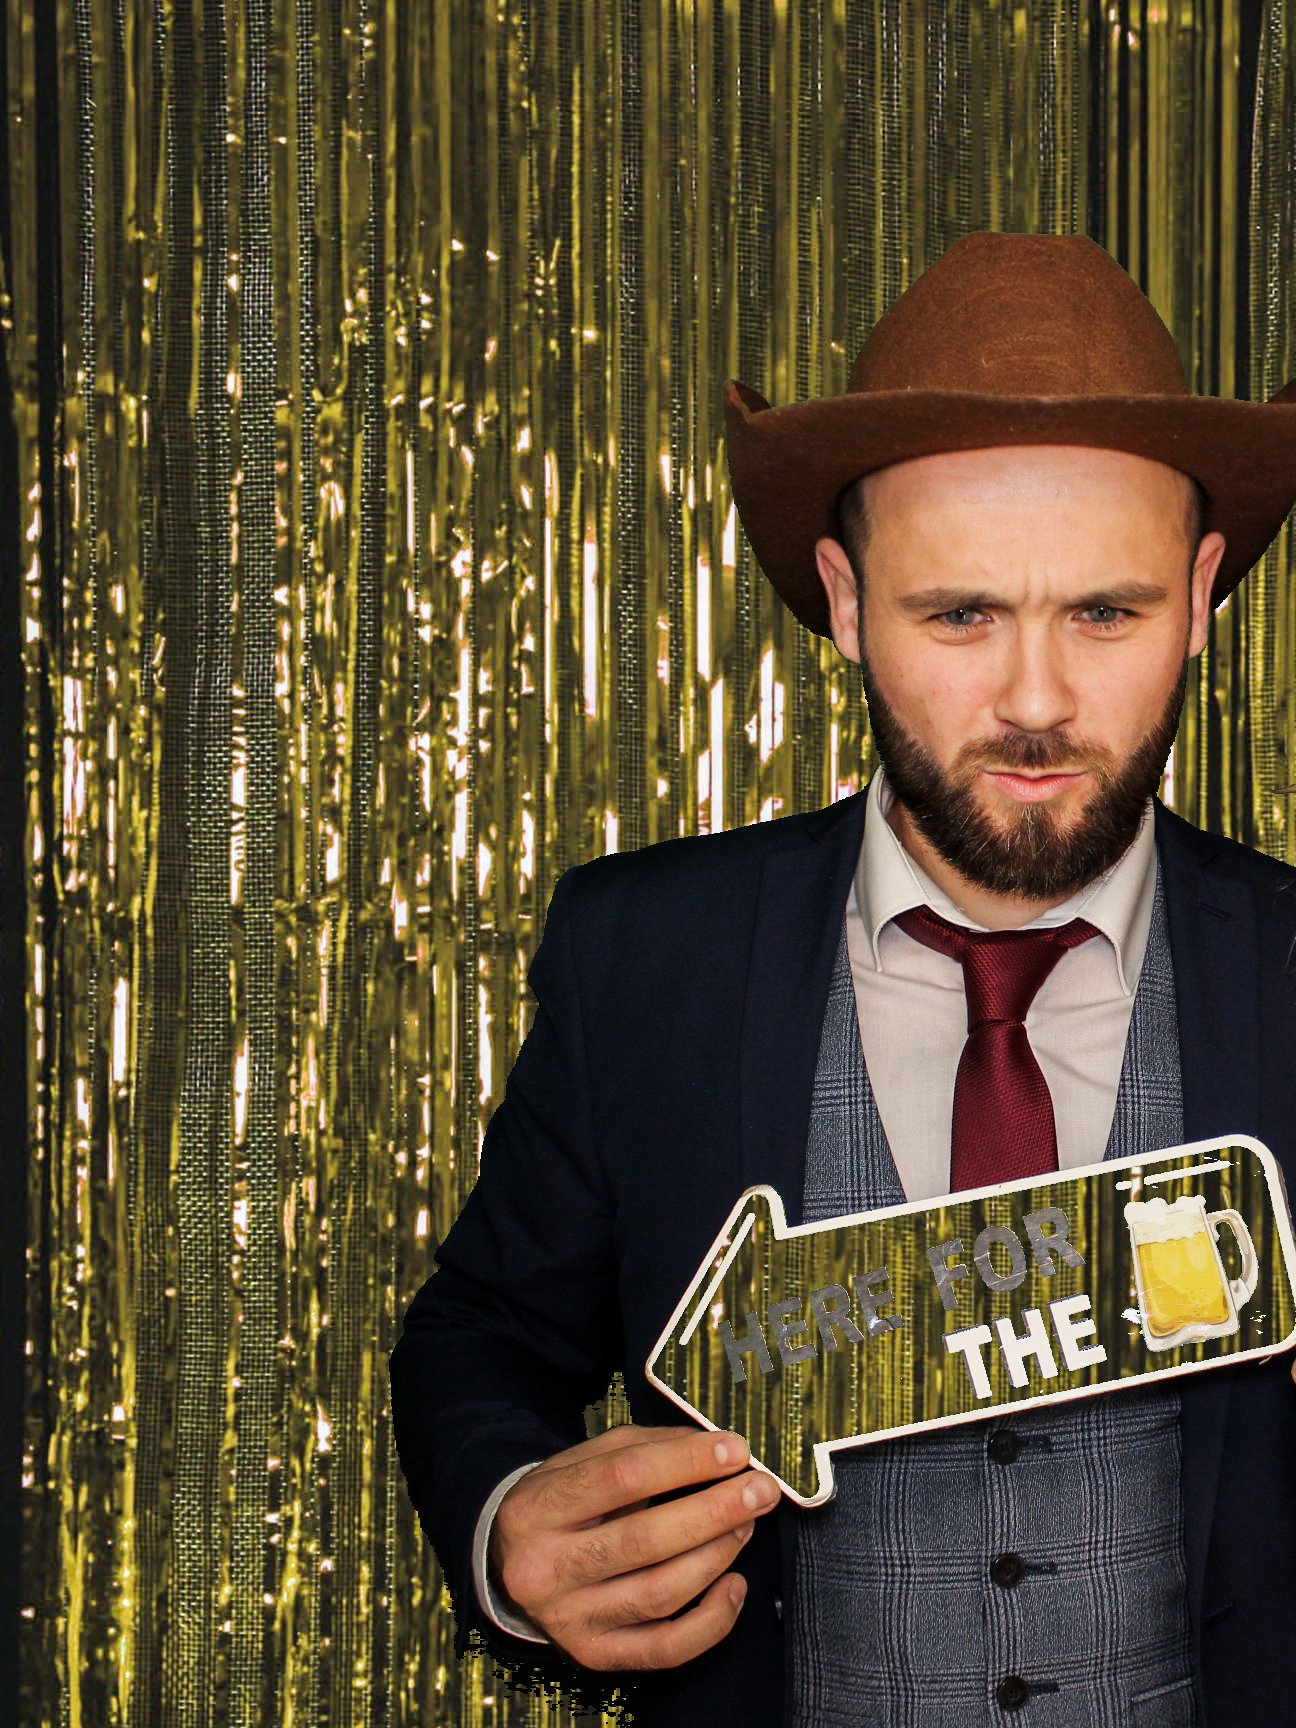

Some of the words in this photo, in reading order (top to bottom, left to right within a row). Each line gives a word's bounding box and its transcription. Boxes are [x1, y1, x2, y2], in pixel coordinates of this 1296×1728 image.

[718, 1267, 904, 1383] HERE
[927, 1207, 1085, 1311] FOR
[943, 1294, 1107, 1399] THE
